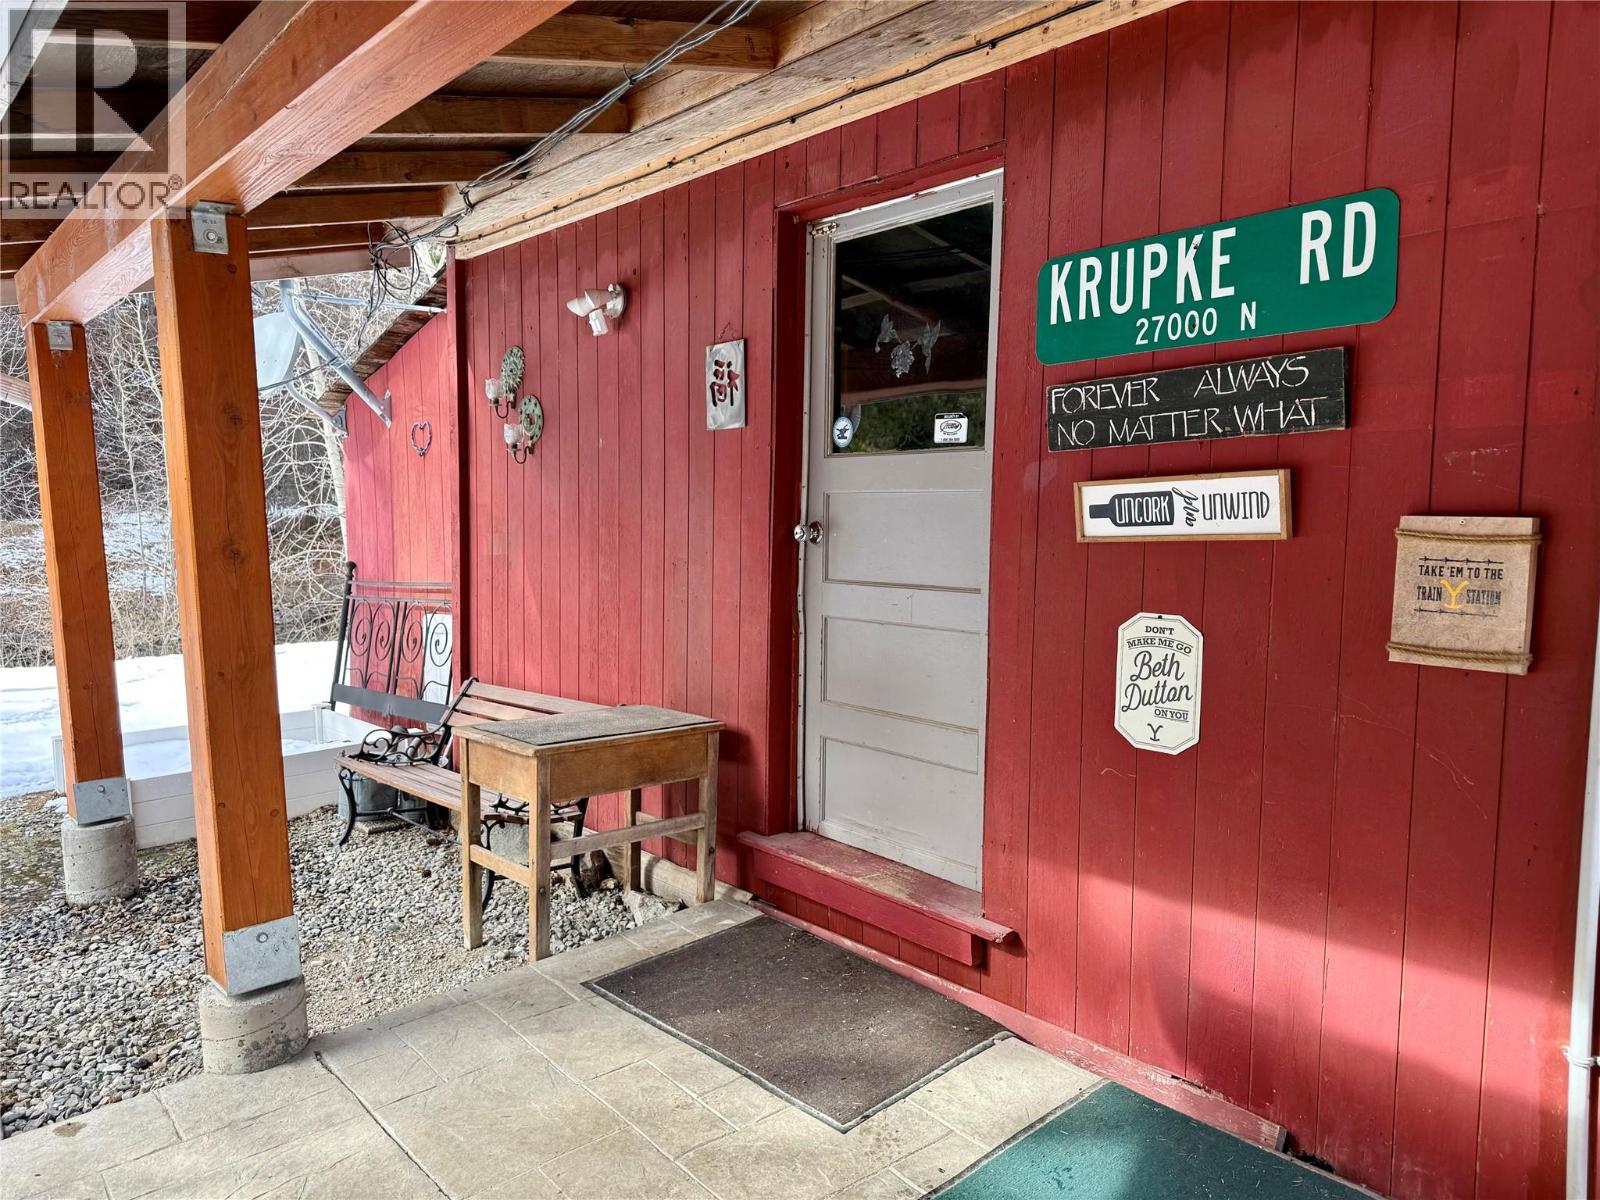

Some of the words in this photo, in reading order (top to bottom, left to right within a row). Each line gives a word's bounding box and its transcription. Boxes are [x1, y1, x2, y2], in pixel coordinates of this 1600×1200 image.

[1050, 227, 1236, 325] KRUPKE
[1300, 201, 1377, 285] RD
[1135, 307, 1218, 345] 27000
[1240, 301, 1256, 332] N
[1051, 377, 1160, 414] FOREVER
[1194, 356, 1309, 397] ALWAYS
[1057, 419, 1095, 446] NO
[1233, 396, 1328, 433] WHAT
[1418, 564, 1444, 577] TAKE
[1467, 567, 1480, 579] TO
[1483, 567, 1504, 580] THE
[1416, 585, 1442, 602] TRAIN
[1465, 589, 1502, 606] STATION
[1127, 637, 1156, 648] MAKE
[1158, 638, 1175, 648] ME
[1176, 645, 1192, 654] GO
[1145, 625, 1174, 635] DON'T
[1130, 650, 1185, 681] Beth
[1121, 680, 1194, 712] Dutton
[1154, 708, 1168, 717] ON
[1169, 710, 1189, 720] YOU
